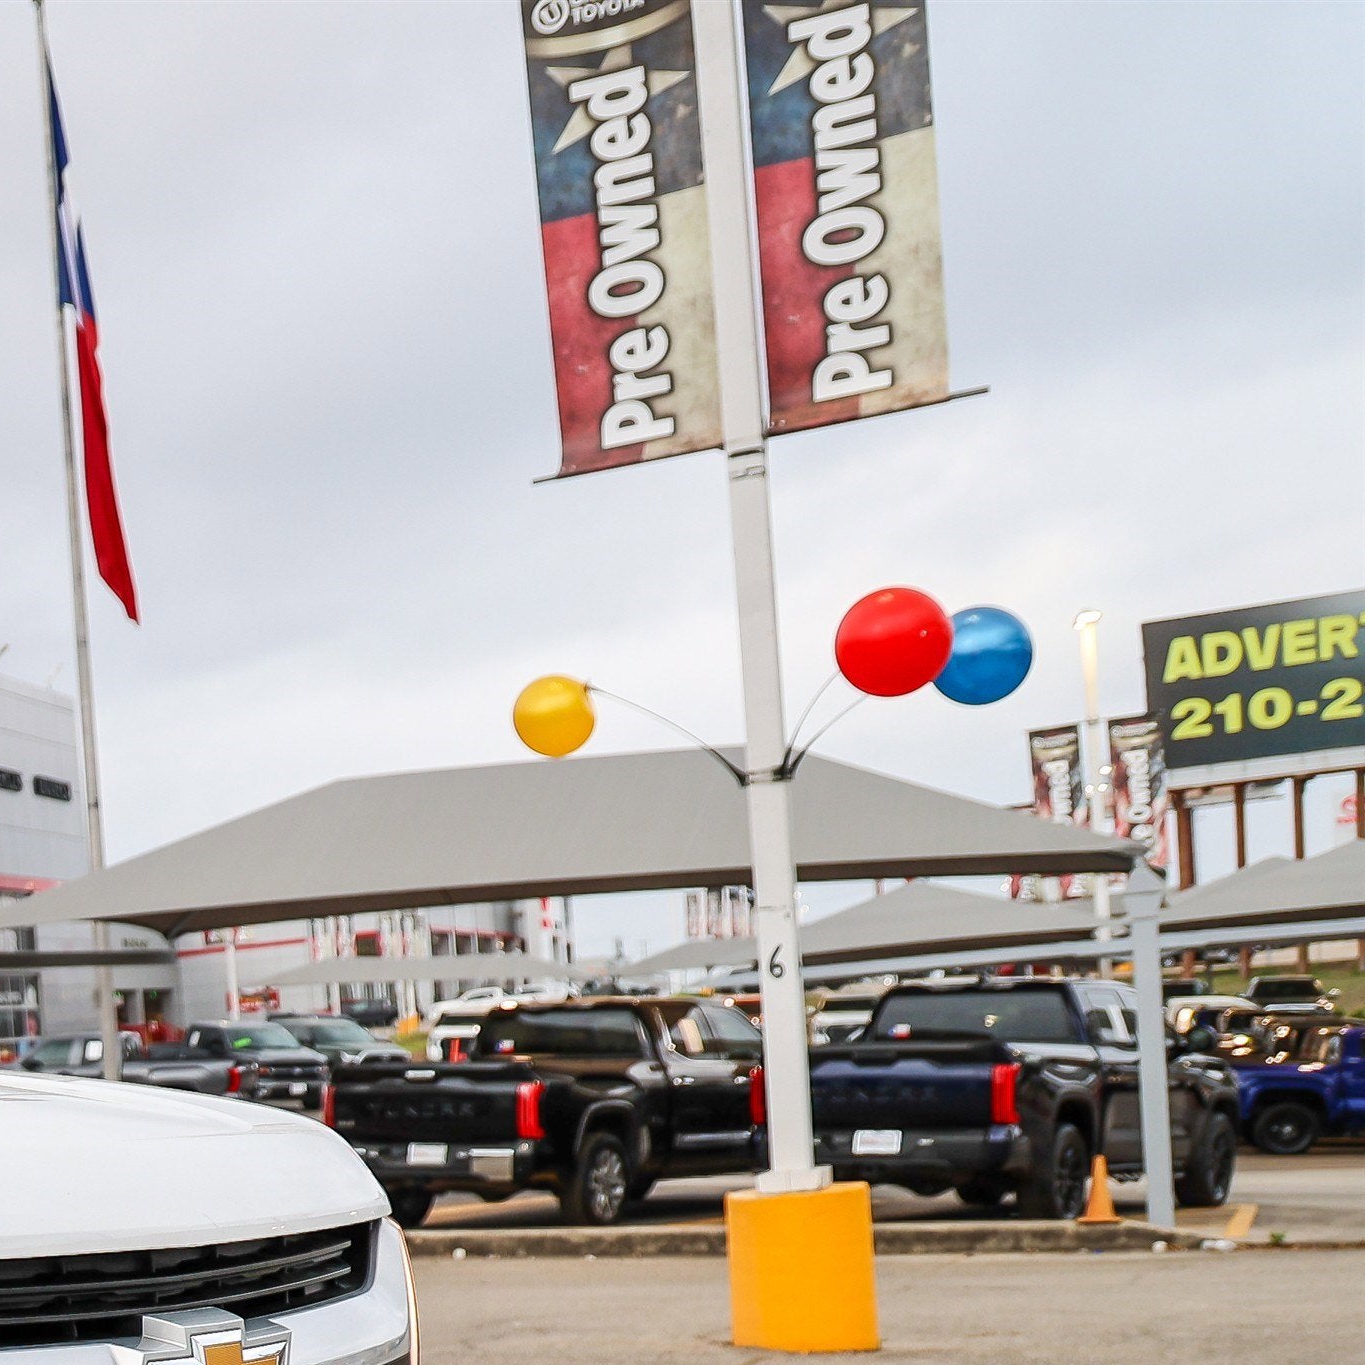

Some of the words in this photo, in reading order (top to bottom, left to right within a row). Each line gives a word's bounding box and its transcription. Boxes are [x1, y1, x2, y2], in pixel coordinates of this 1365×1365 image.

[569, 64, 665, 319] Owned
[787, 3, 886, 267] Owned
[599, 324, 675, 450] Pre
[812, 273, 893, 403] Pre
[1162, 611, 1365, 684] ADVER
[1170, 677, 1365, 740] 210-2
[769, 944, 785, 979] 6
